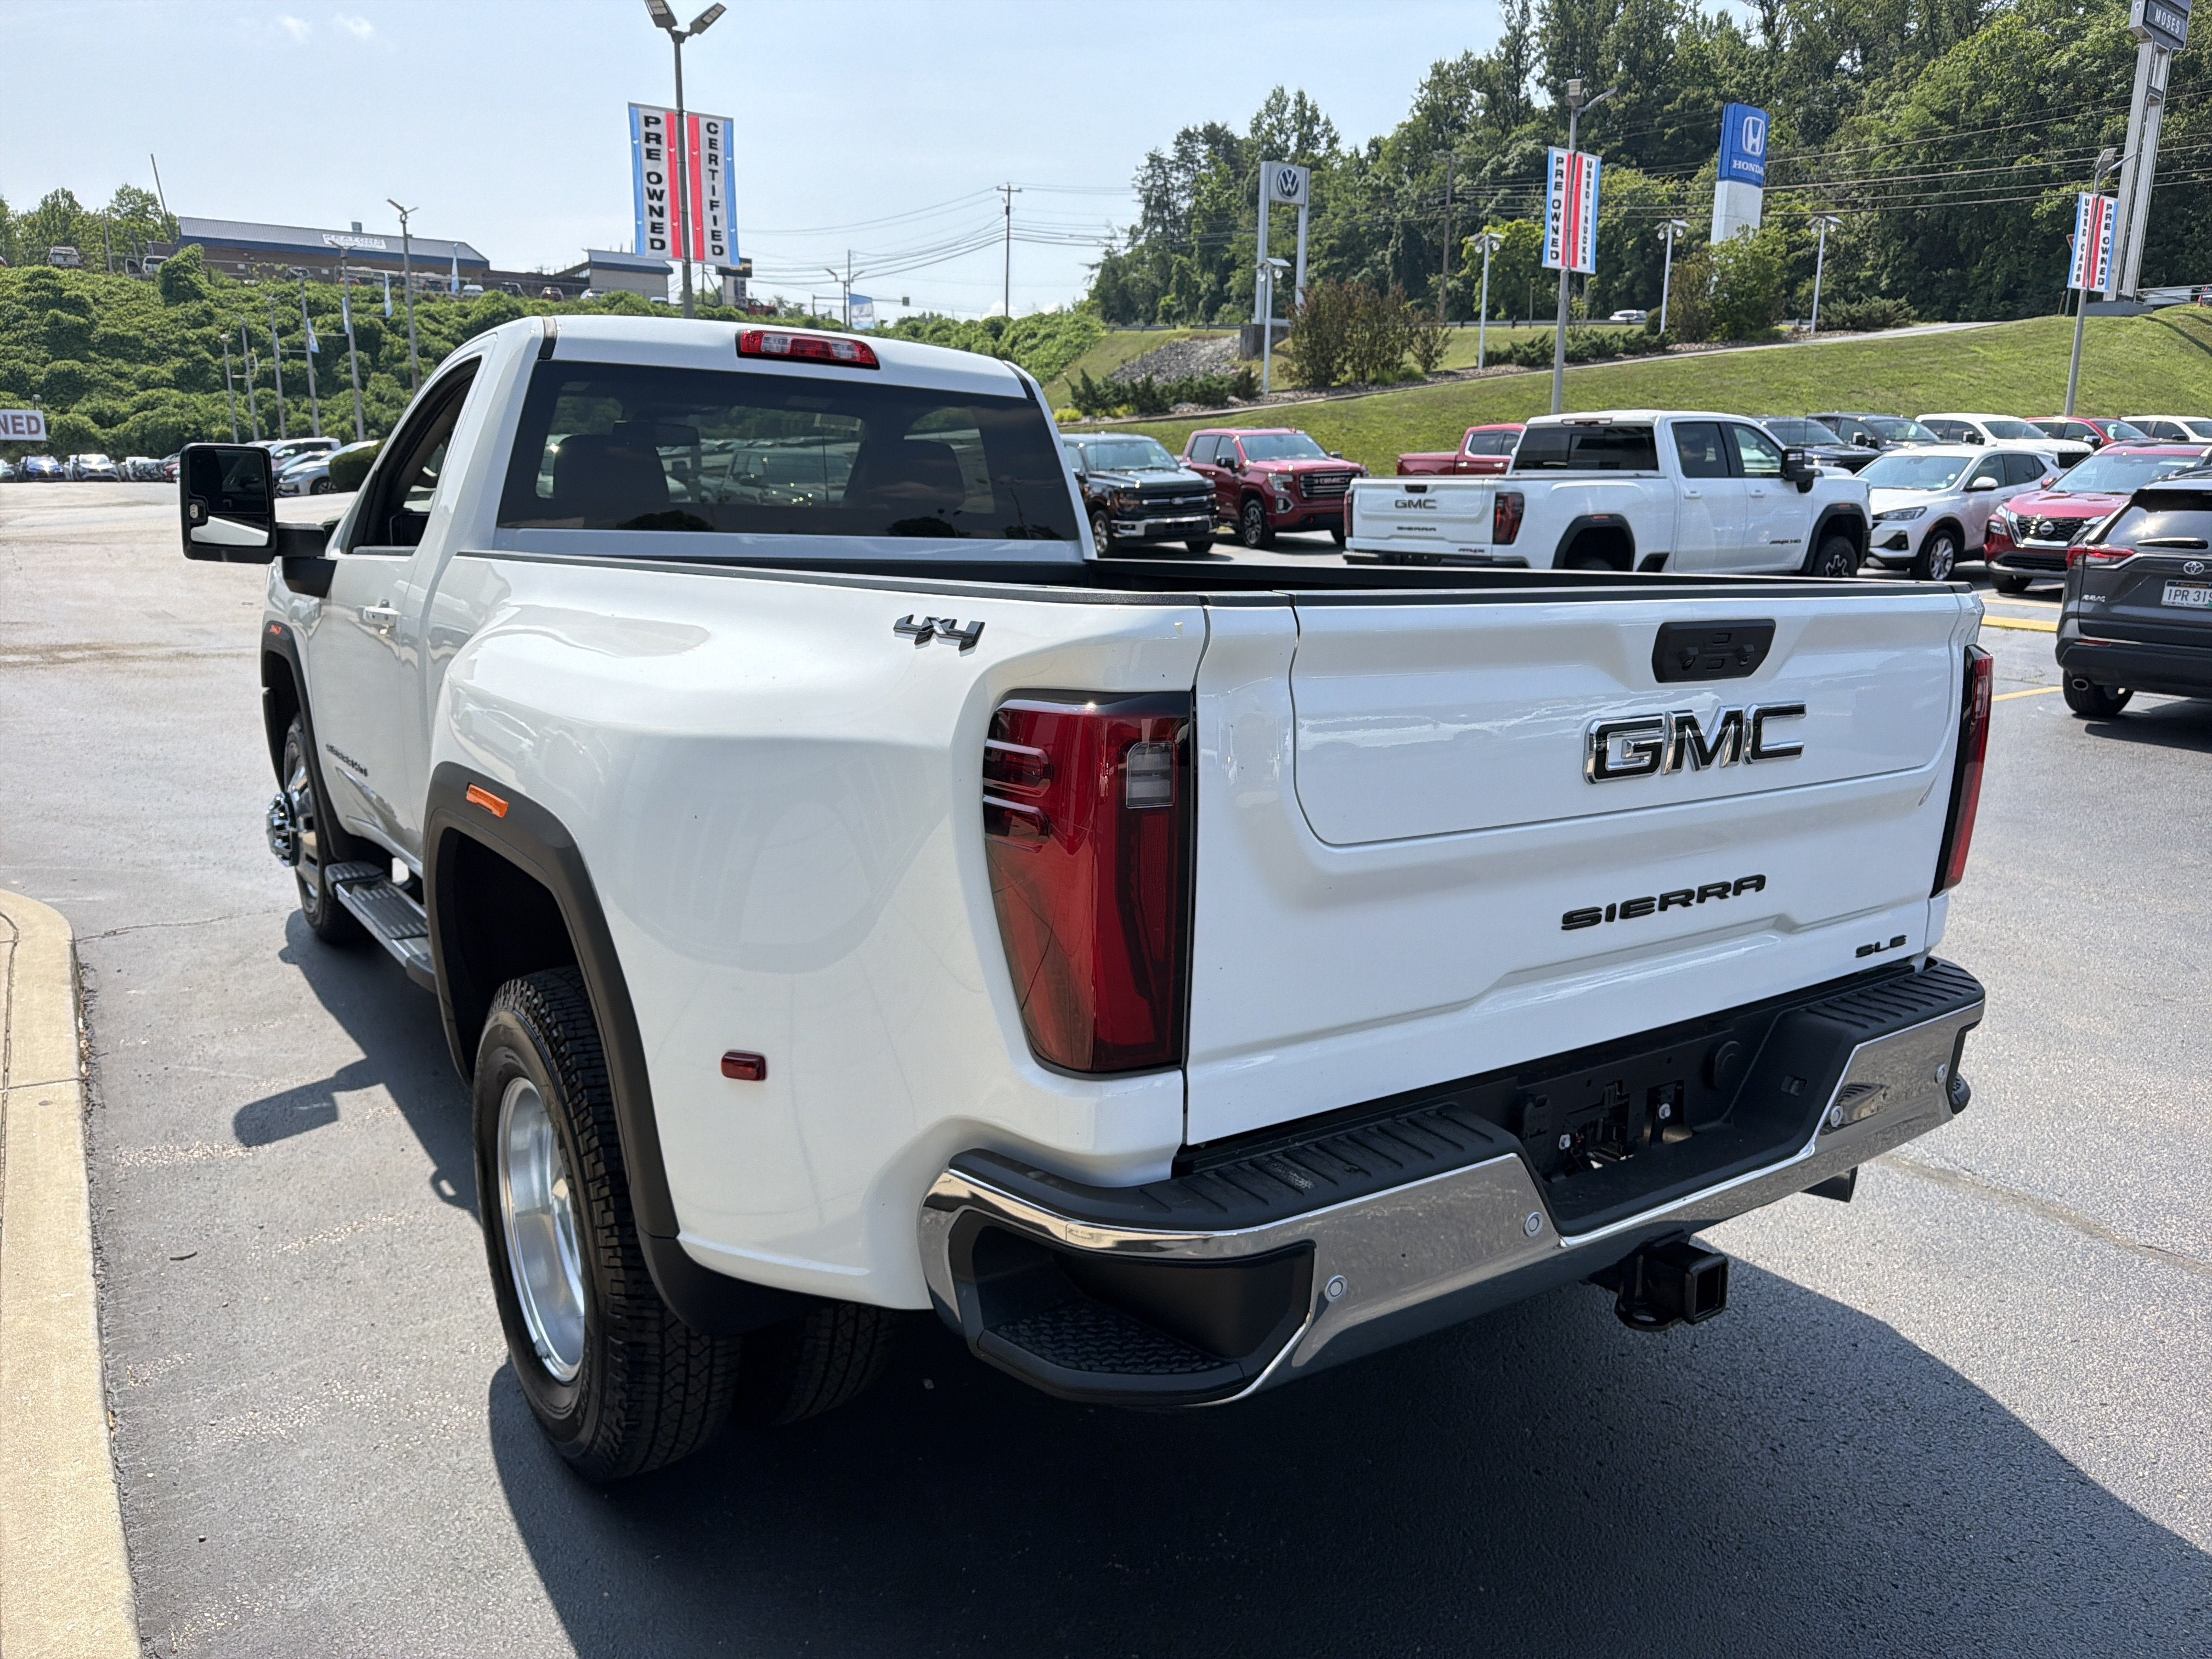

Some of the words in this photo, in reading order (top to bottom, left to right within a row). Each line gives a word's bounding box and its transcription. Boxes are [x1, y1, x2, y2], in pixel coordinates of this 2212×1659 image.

[2154, 8, 2180, 34] MOSES
[644, 115, 662, 161] PRE
[706, 122, 724, 256] CERTIFIED
[1554, 156, 1564, 191] PRE
[646, 171, 666, 251] OWNED
[1550, 199, 1561, 260] OWNED
[2104, 204, 2112, 230] PRE
[2075, 243, 2085, 282] CARS
[2097, 236, 2109, 285] OWNED
[1395, 499, 1437, 509] GMC
[1582, 701, 1806, 785] GMC
[1561, 874, 1766, 931] SIERRA
[1855, 934, 1908, 958] SLE
